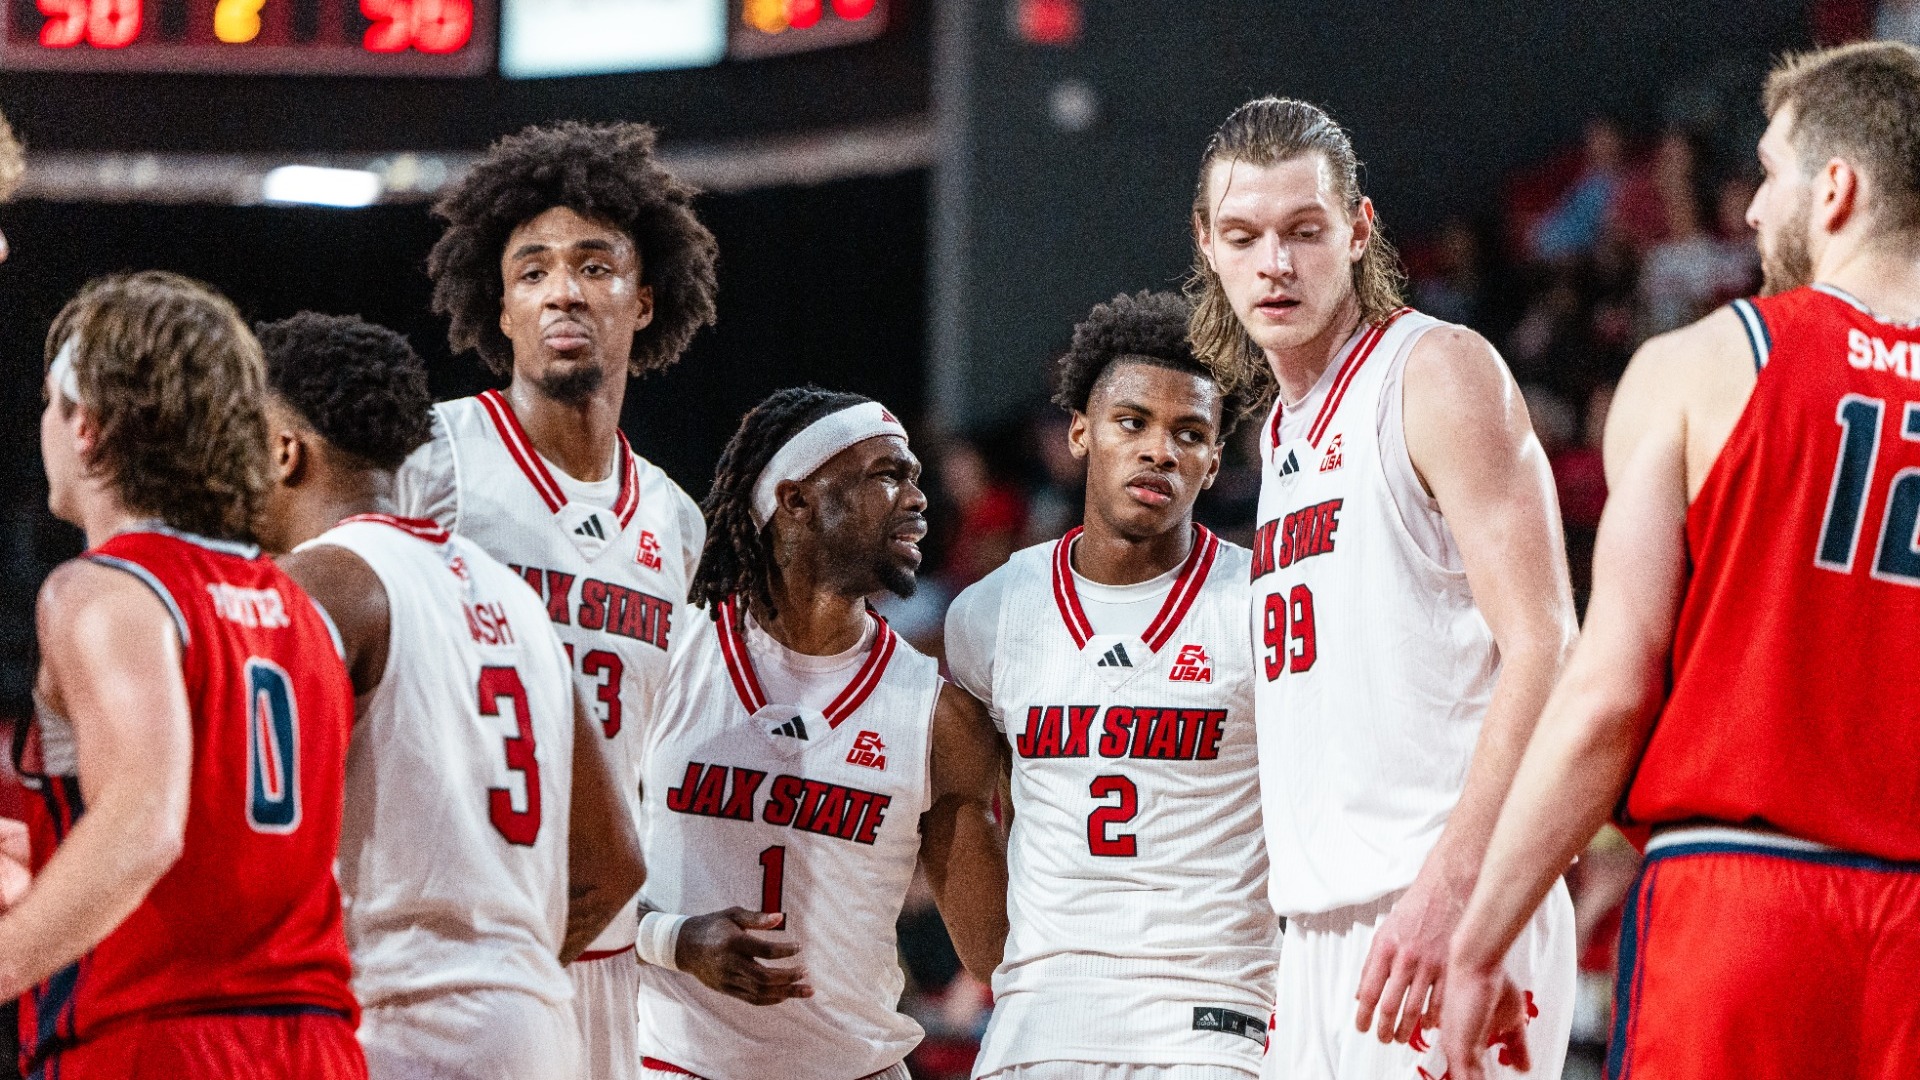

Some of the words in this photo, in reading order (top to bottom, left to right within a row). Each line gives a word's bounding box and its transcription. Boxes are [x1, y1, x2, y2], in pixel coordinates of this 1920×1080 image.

[1319, 453, 1342, 472] USA
[637, 549, 662, 572] USA
[1250, 517, 1280, 586] AX
[1279, 498, 1344, 569] STATE
[508, 563, 576, 626] AX
[578, 577, 673, 652] STATE
[1264, 583, 1317, 682] 99
[563, 642, 624, 739] 3
[1168, 665, 1211, 682] USA
[244, 655, 303, 834] 0
[477, 664, 541, 847] 3
[845, 749, 886, 771] USA
[1016, 704, 1100, 759] JAX
[1099, 705, 1228, 761] STATE
[667, 761, 767, 822] JAX
[762, 773, 892, 846] STATE
[1087, 775, 1138, 857] 2
[759, 845, 786, 930] 1
